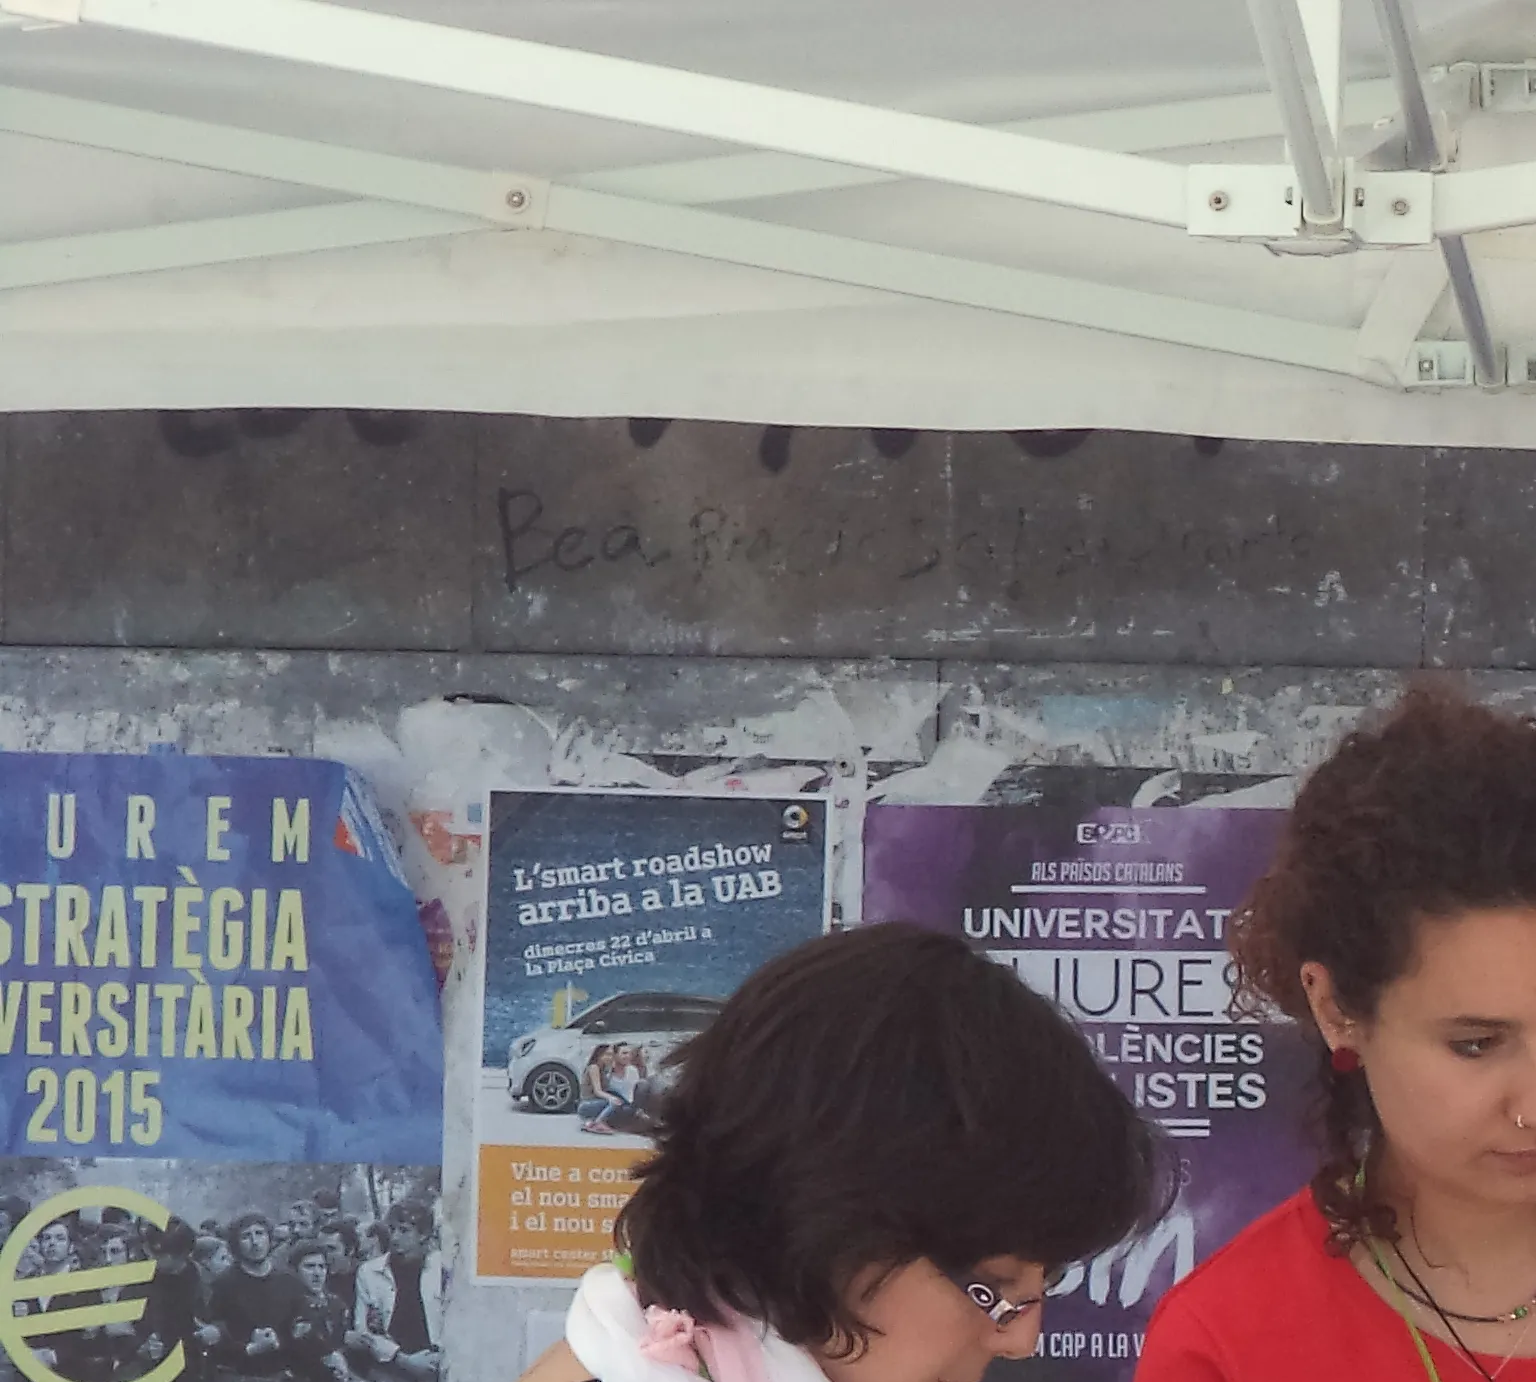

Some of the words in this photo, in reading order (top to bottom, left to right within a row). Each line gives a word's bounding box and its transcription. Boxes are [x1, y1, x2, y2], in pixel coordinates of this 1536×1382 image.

[497, 487, 662, 593] Bea
[513, 857, 626, 892] L'smart
[632, 843, 774, 876] roadshow
[1031, 861, 1057, 882] ALS
[1114, 862, 1184, 883] CATALANS
[518, 888, 633, 926] arriba
[640, 887, 664, 912] a
[668, 879, 705, 908] la
[711, 869, 784, 904] UAB
[523, 937, 606, 960] dimecres
[610, 934, 631, 950] 22
[636, 926, 697, 948] d'abril
[702, 926, 712, 939] a
[525, 961, 543, 976] la
[547, 952, 595, 976] Plaça
[1087, 1025, 1264, 1064] LÈNCIES
[26, 1067, 162, 1145] 2015
[1114, 1071, 1266, 1109] ISTES
[511, 1160, 561, 1182] Vine
[568, 1168, 581, 1182] a
[511, 1186, 532, 1206] el
[539, 1193, 581, 1207] nou
[509, 1211, 519, 1230] i
[524, 1212, 547, 1231] el
[553, 1217, 595, 1232] nou
[1050, 1333, 1085, 1358] CAP
[1091, 1333, 1102, 1357] A
[1108, 1333, 1128, 1358] LA
